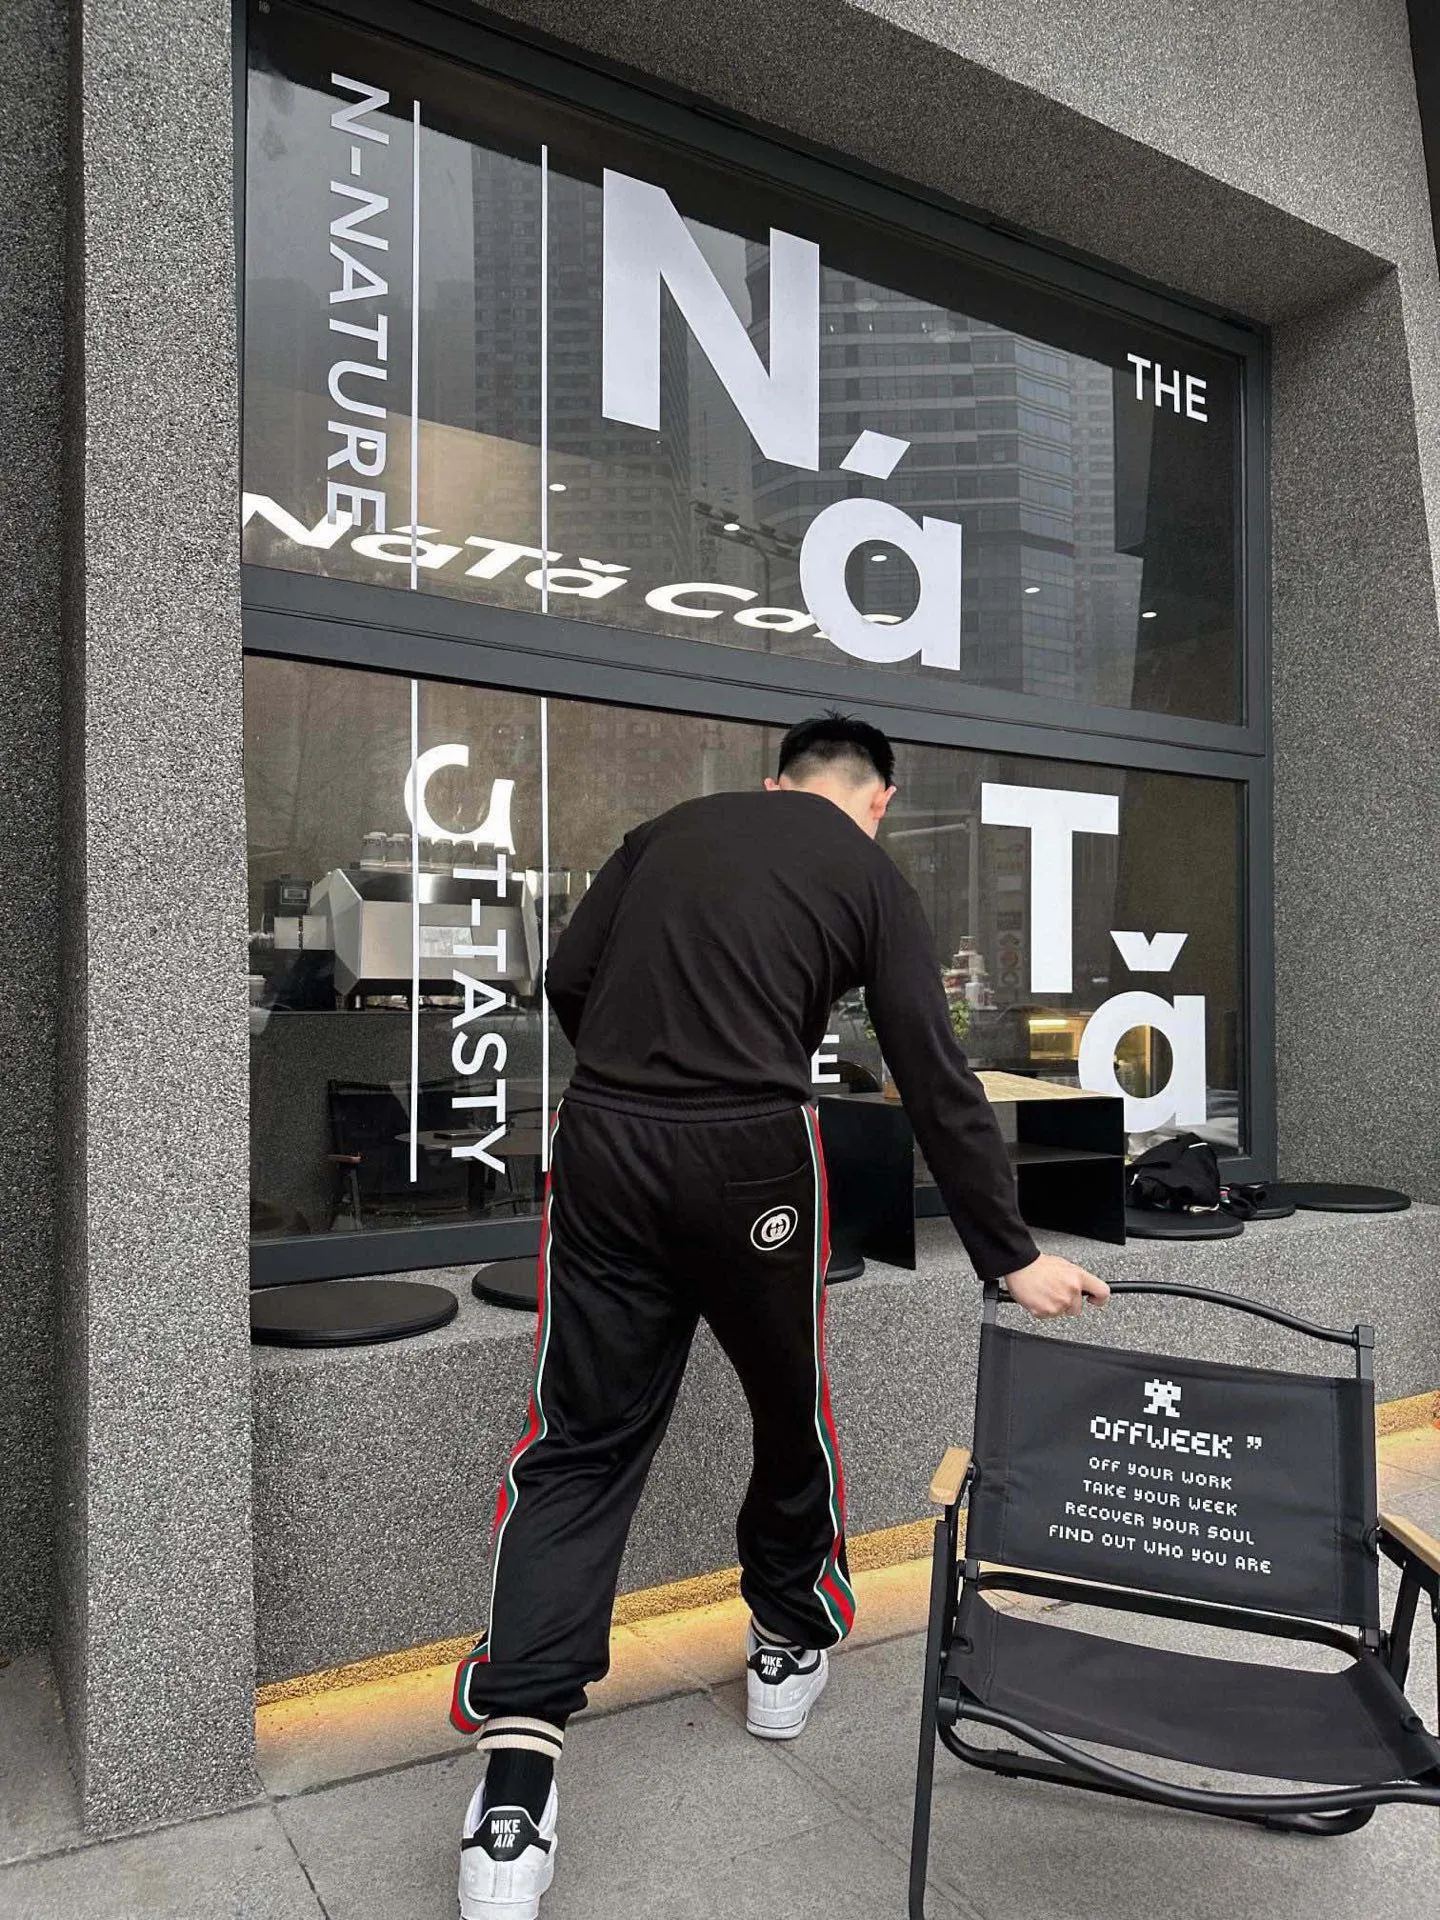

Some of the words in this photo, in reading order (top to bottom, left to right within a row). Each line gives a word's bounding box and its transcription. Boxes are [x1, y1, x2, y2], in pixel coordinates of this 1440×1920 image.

[327, 72, 390, 533] N-NATURE
[1127, 352, 1208, 423] THE
[452, 853, 507, 1174] T-TASTY
[1090, 1415, 1232, 1459] OFFWEEK
[1089, 1456, 1120, 1472] OFF
[1128, 1462, 1173, 1482] YOUR
[1182, 1470, 1232, 1490] WORK
[1083, 1479, 1126, 1498] TAKE
[1134, 1488, 1180, 1507] YOUR
[1189, 1496, 1237, 1516] WEEK
[1065, 1501, 1144, 1527] RECOVER
[1152, 1516, 1199, 1536] YOUR
[1208, 1525, 1255, 1545] SOUL
[1049, 1524, 1094, 1544] FIND
[1102, 1532, 1136, 1550] OUT
[1144, 1539, 1183, 1559] WHO
[1191, 1547, 1226, 1566] YOU
[1235, 1555, 1271, 1574] ARE
[761, 1653, 783, 1668] NIKE
[762, 1665, 778, 1676] AIR
[491, 1819, 520, 1834] NIKE
[494, 1833, 516, 1848] AIR
